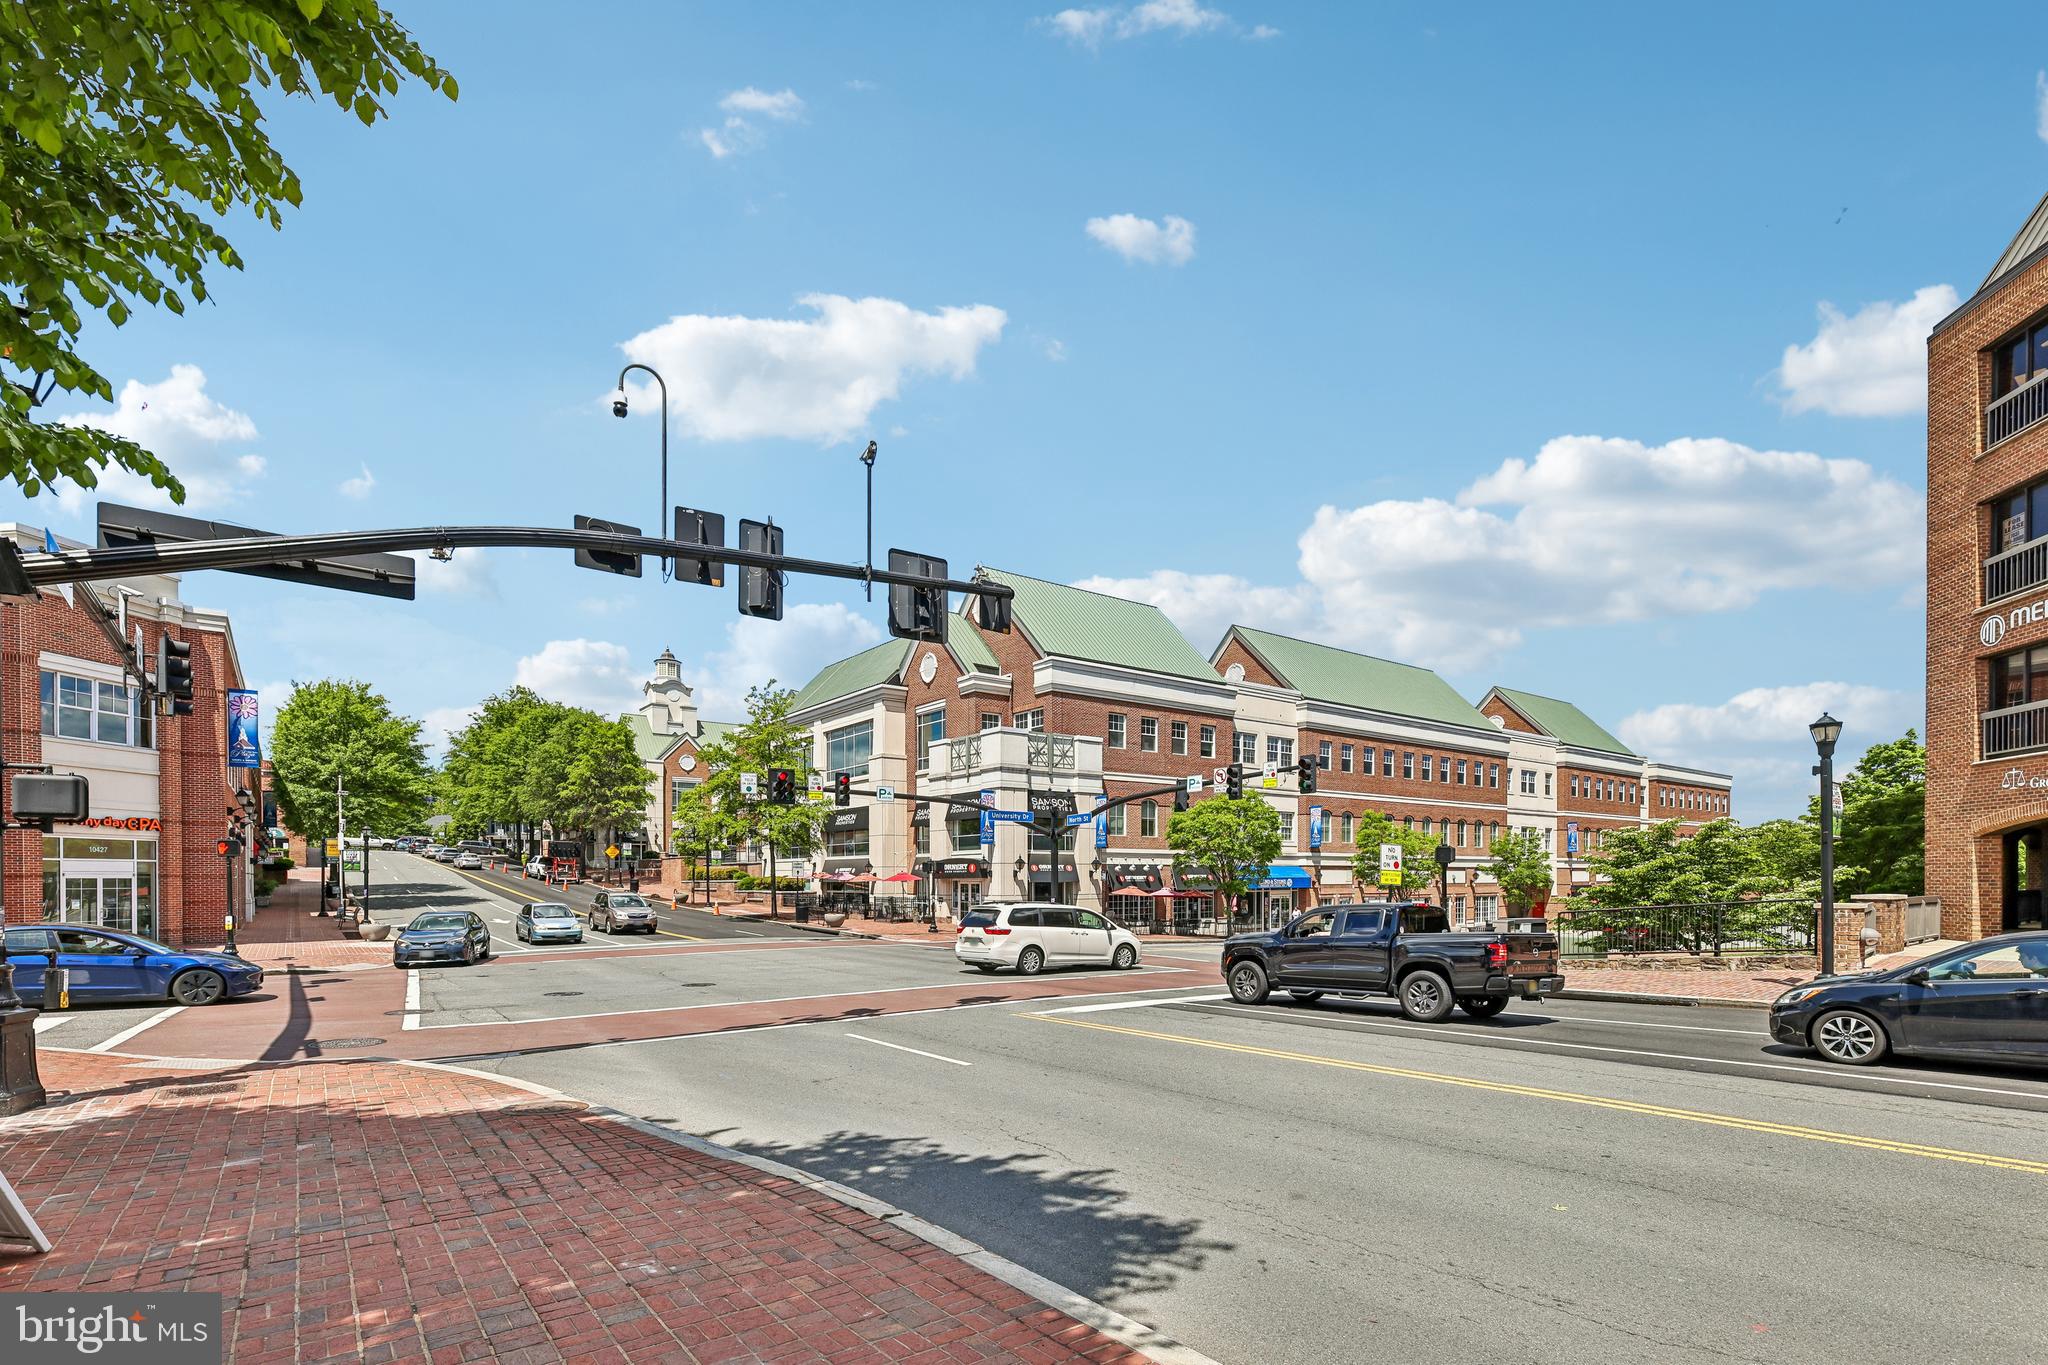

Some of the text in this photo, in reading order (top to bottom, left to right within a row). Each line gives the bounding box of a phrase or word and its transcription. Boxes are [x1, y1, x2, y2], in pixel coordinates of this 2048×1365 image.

[2010, 599, 2048, 628] ME
[2030, 776, 2048, 788] GR
[837, 813, 857, 821] SAMSON
[991, 812, 1021, 820] University
[1068, 815, 1082, 823] North
[103, 816, 127, 829] day
[127, 817, 162, 831] CPA
